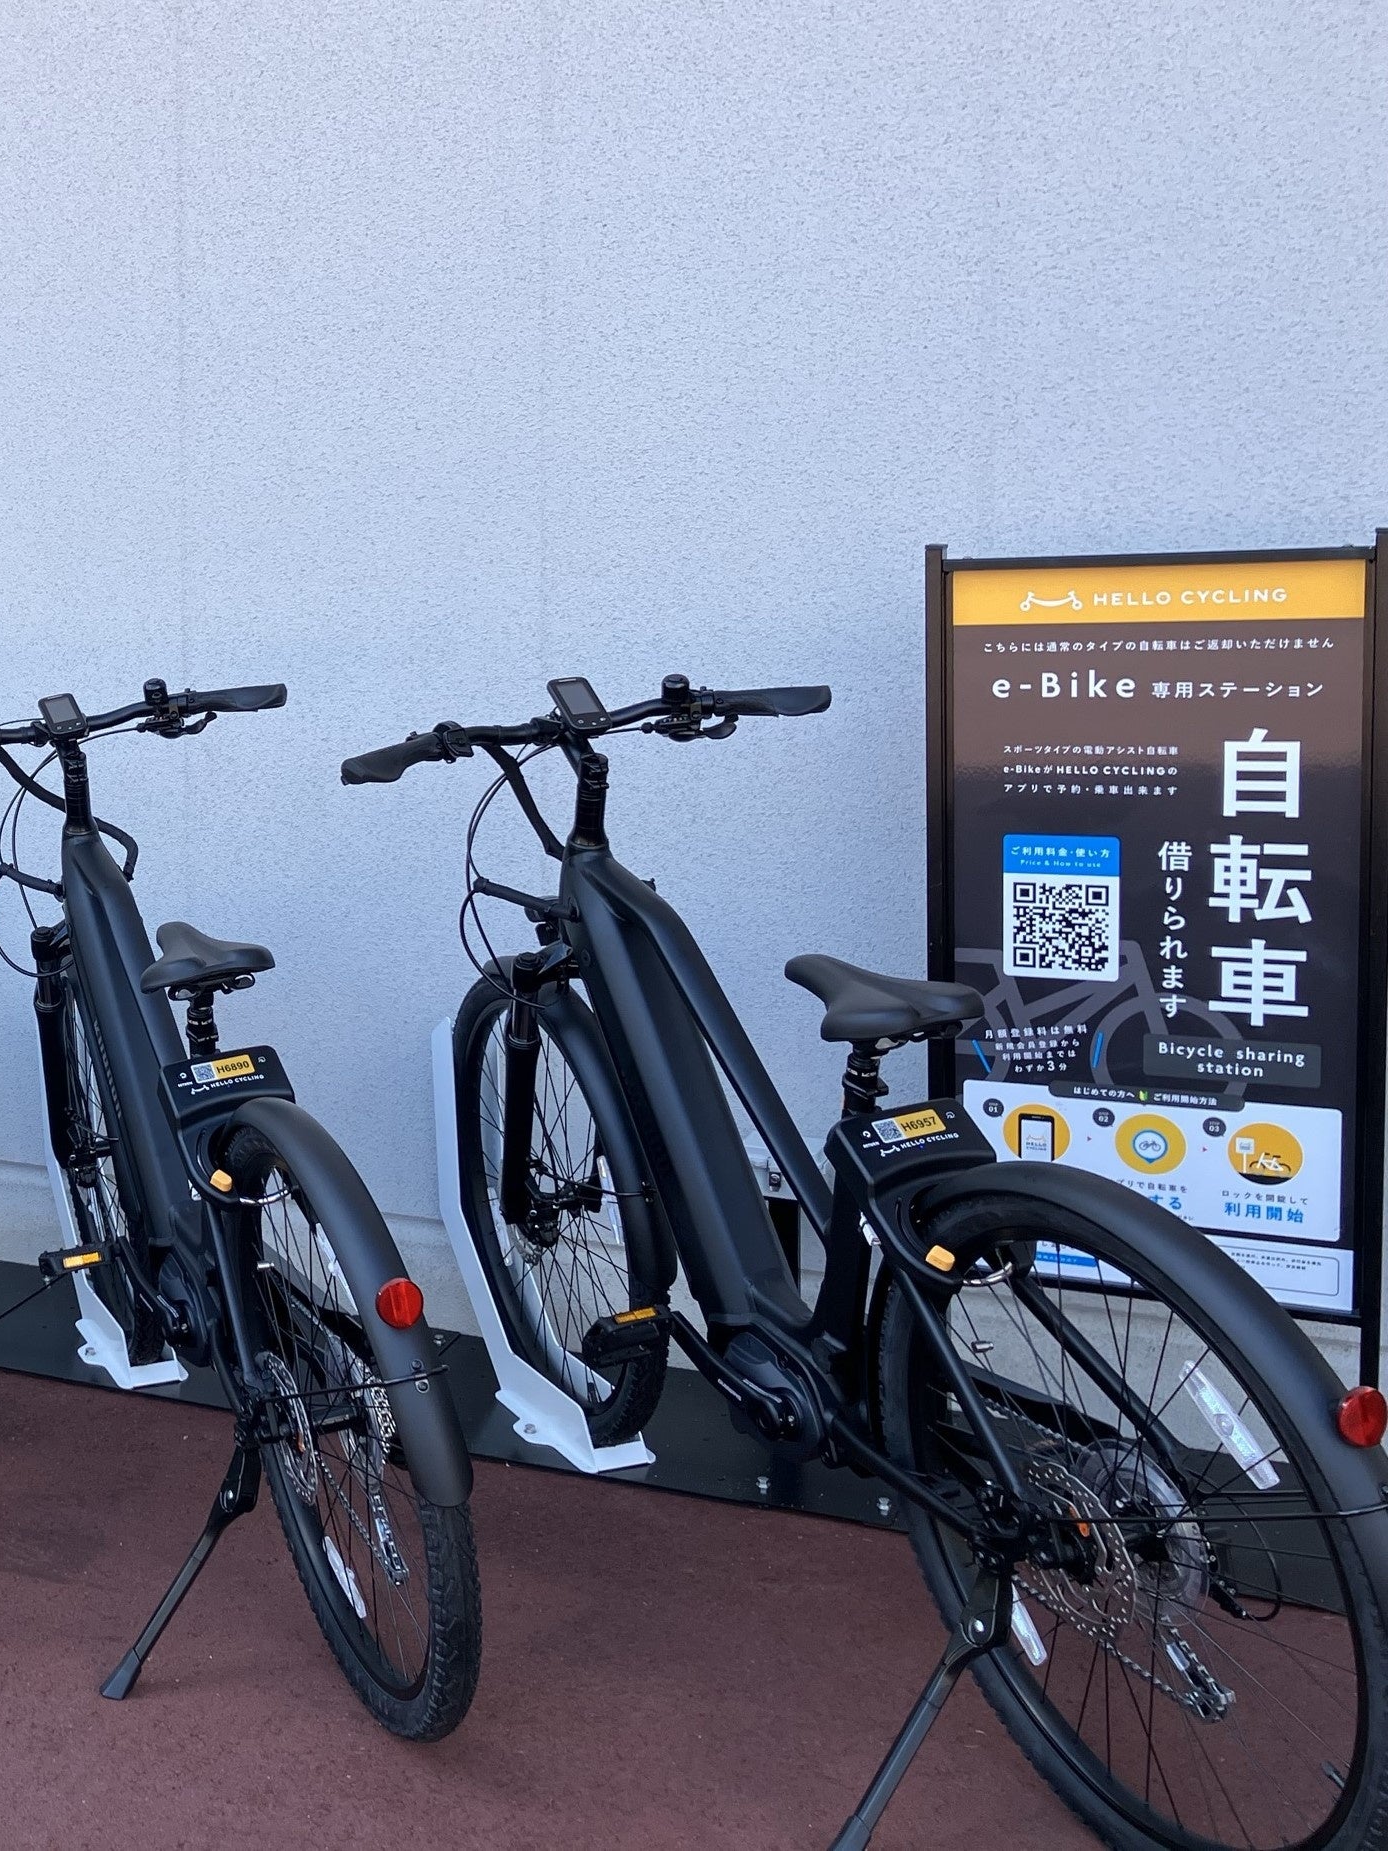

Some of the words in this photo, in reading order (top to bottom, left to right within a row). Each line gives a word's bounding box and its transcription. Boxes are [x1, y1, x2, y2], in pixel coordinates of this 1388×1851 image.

[1093, 591, 1172, 606] HELLO
[1180, 588, 1288, 605] CYCLING
[983, 637, 1334, 653] こちらには通常のタイプの自転車はご返却いただけません
[991, 669, 1136, 699] e-Bike
[1151, 681, 1324, 699] 専用ステーション
[1003, 745, 1179, 756] スポーツタイプの電動アシスト自転車
[1056, 765, 1099, 775] HELLO
[1208, 727, 1312, 1027] 自転車
[1158, 841, 1193, 1018] 借りられます
[1158, 1041, 1224, 1060] Bicycle
[1235, 1046, 1306, 1068] sharing
[216, 1060, 250, 1075] H6890
[1197, 1062, 1264, 1077] station
[210, 1078, 234, 1089] HELLO
[234, 1073, 265, 1084] CYCLING
[1073, 1086, 1136, 1099] はじめての方へ
[988, 1105, 998, 1113] 01
[900, 1116, 937, 1132] H6957
[1098, 1115, 1109, 1123] 02
[900, 1137, 927, 1150] HELLO
[927, 1132, 960, 1143] CYCLING
[1224, 1201, 1304, 1223] 利用開始
